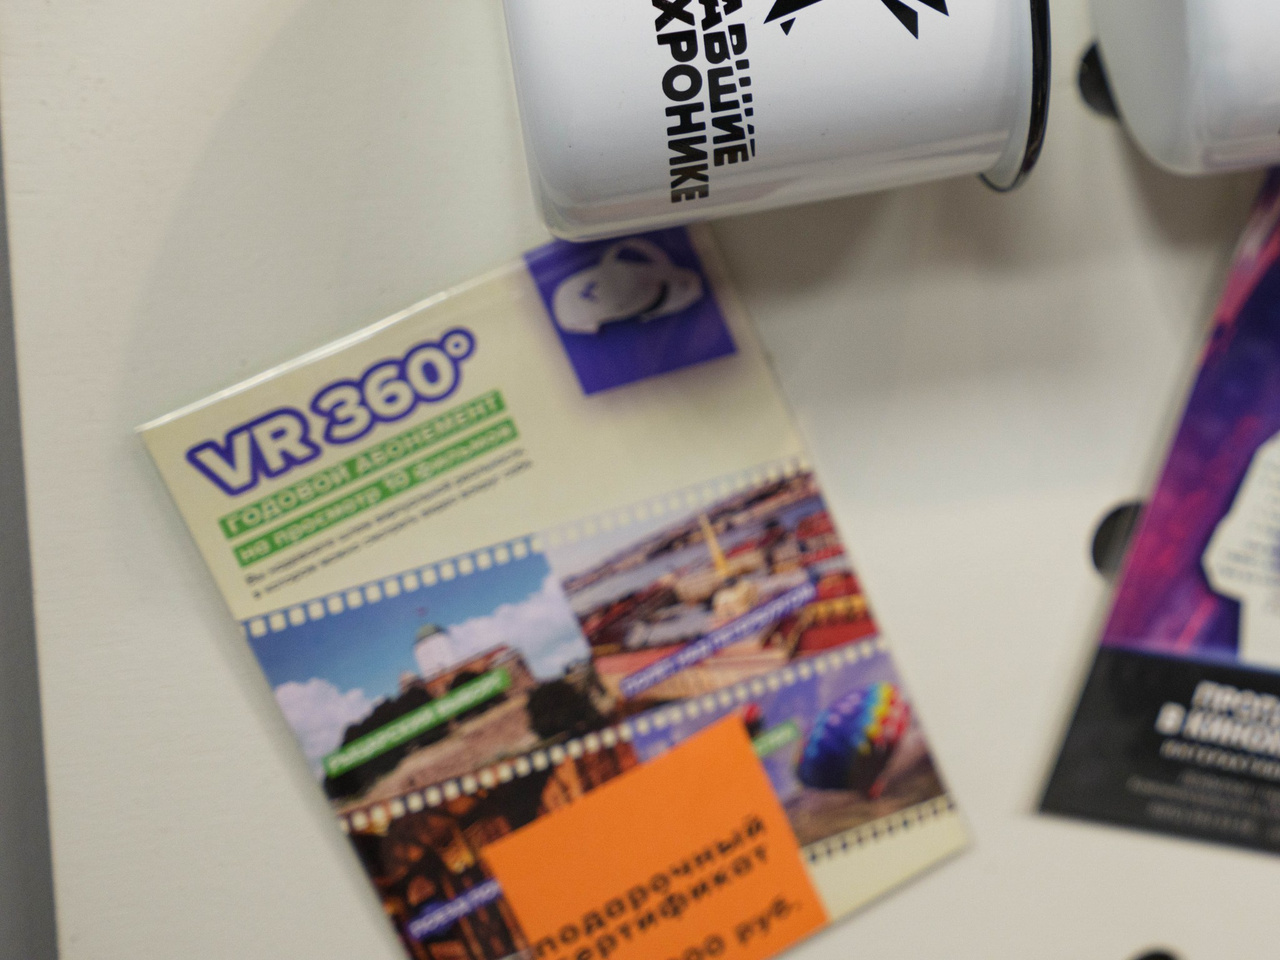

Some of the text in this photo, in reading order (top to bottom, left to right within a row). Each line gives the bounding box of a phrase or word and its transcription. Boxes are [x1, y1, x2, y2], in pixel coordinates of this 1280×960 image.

[187, 327, 476, 496] VR 360°
[225, 465, 352, 534] ГОДОВОЙ
[354, 392, 501, 474] АБОНЕМЕНТ
[238, 539, 272, 564] на
[273, 488, 384, 546] просмотр
[558, 843, 769, 960] ертификат
